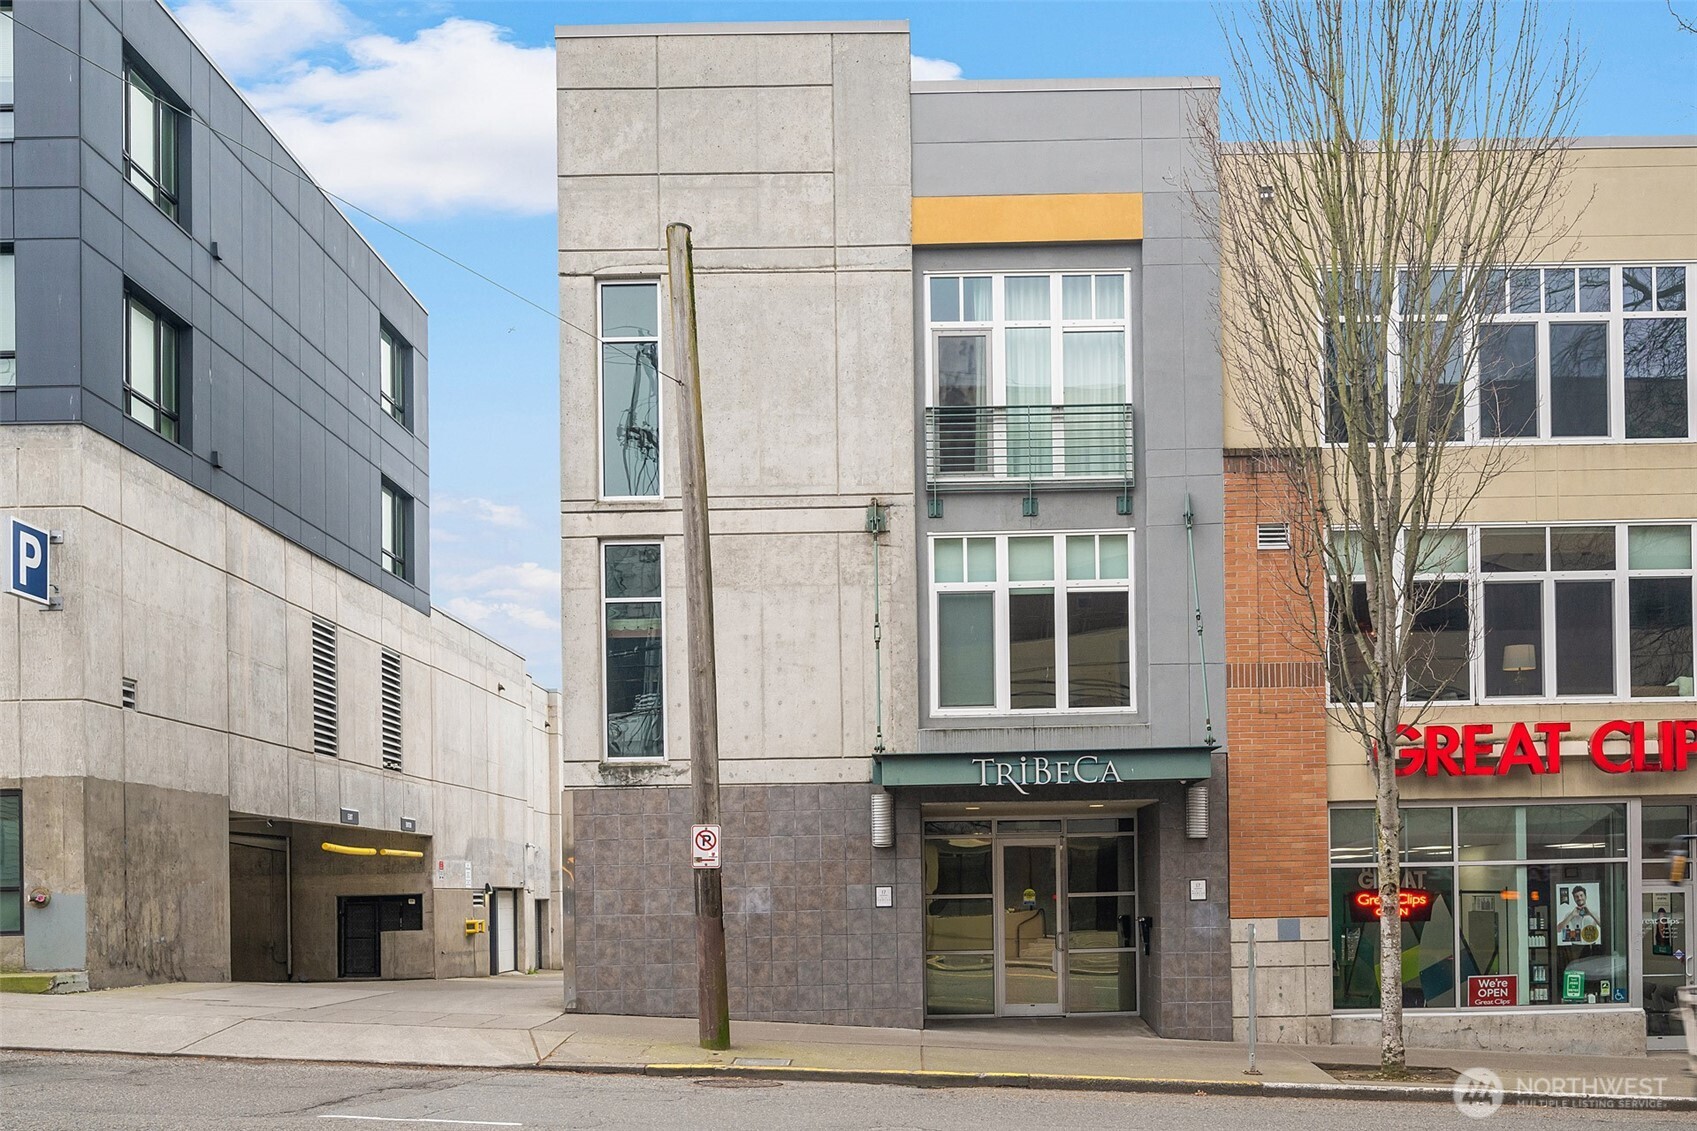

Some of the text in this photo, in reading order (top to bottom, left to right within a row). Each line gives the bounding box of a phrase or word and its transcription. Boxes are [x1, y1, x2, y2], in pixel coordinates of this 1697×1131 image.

[19, 530, 42, 586] P
[1372, 721, 1571, 777] GREAT
[1375, 908, 1409, 916] ON
[1478, 978, 1508, 988] We're
[1477, 988, 1508, 998] OPEN
[1494, 998, 1511, 1006] Clips
